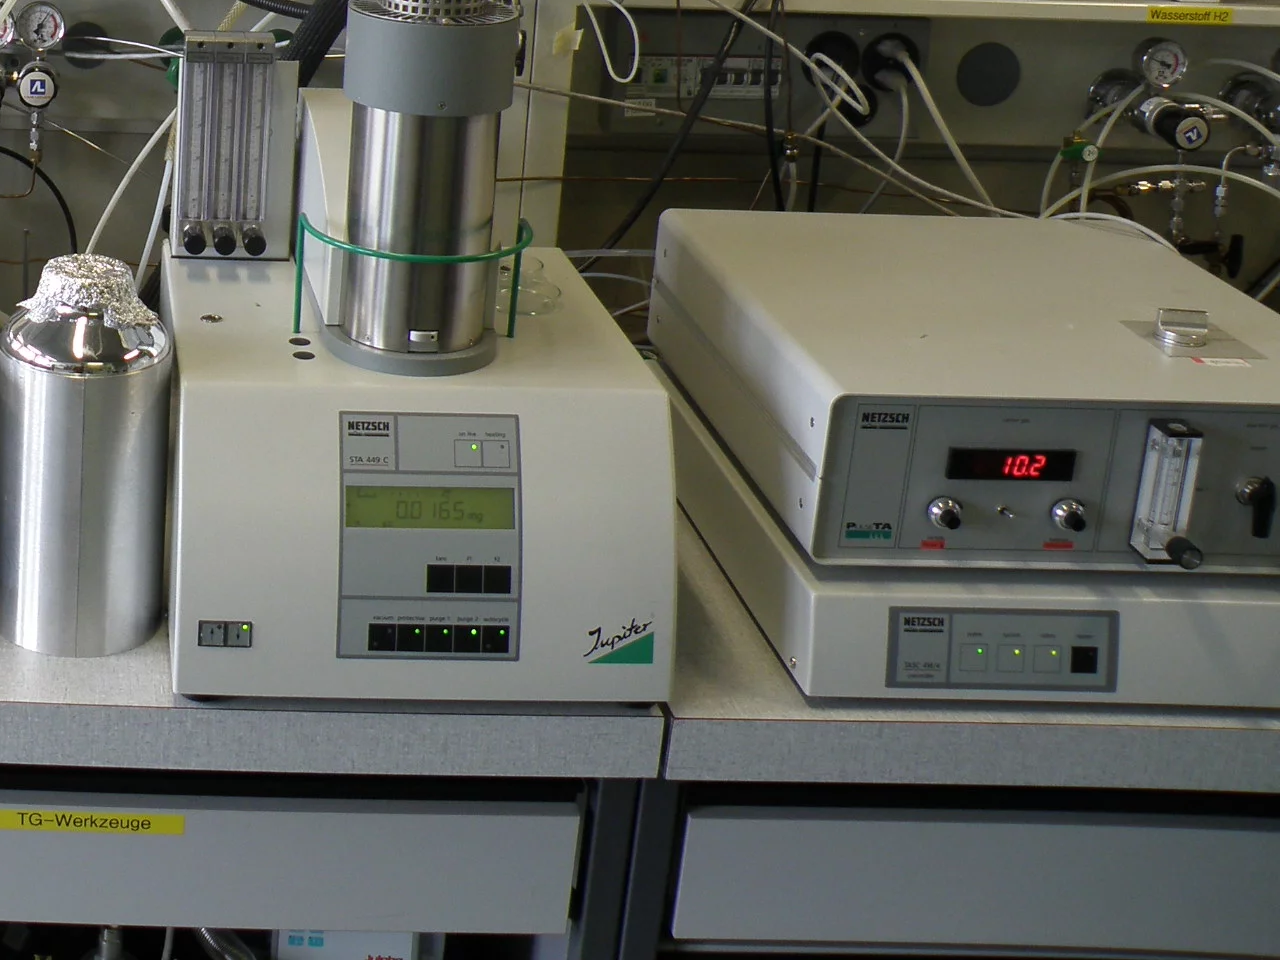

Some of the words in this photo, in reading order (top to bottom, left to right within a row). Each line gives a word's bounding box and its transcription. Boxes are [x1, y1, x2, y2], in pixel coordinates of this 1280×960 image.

[1150, 9, 1212, 21] Wasserstoff
[1214, 12, 1229, 22] H2
[862, 412, 910, 423] NETZSCH
[348, 421, 389, 431] NETZSCH
[366, 456, 381, 464] 449
[383, 456, 389, 464] C
[1002, 455, 1047, 477] 10.2
[904, 617, 944, 626] NETZSCH
[583, 618, 652, 657] Jupiter
[17, 812, 151, 832] TG-Werkzeuge
